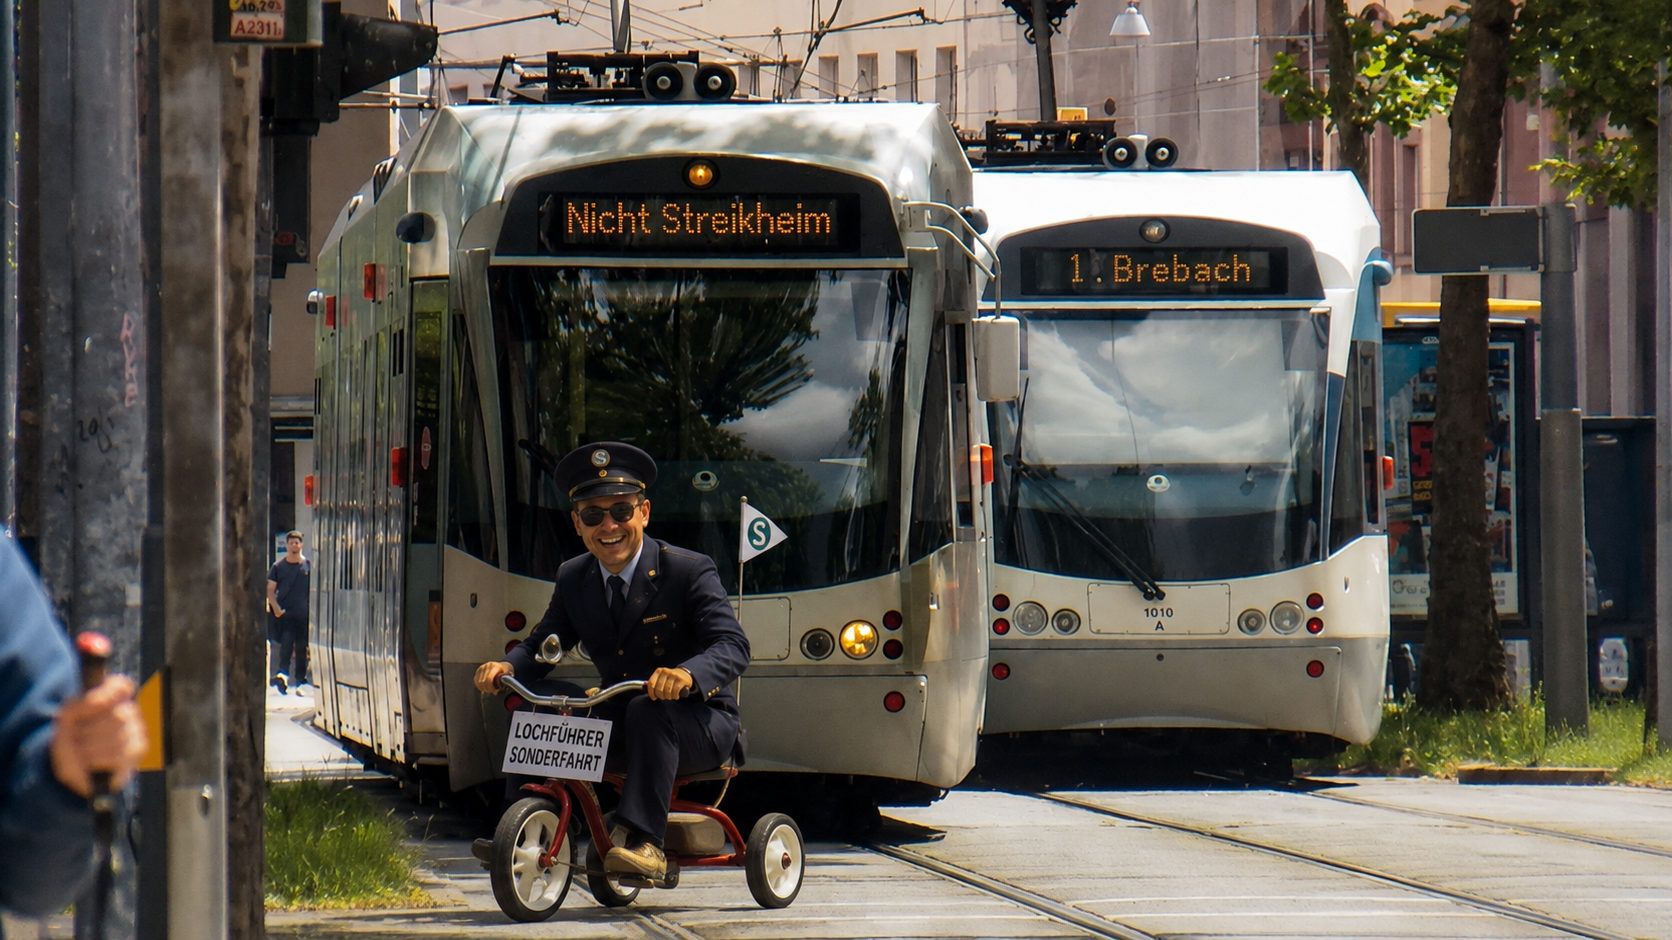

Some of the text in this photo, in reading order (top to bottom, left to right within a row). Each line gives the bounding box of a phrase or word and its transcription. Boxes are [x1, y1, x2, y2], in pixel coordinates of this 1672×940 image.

[566, 202, 831, 234] Nicht Streikheim
[1113, 254, 1251, 283] Brebach
[752, 520, 766, 546] S
[1144, 607, 1174, 618] 1010
[1154, 620, 1165, 631] A
[514, 720, 605, 748] LOCHFÜHRER
[509, 745, 602, 772] SONDERFAHRT
